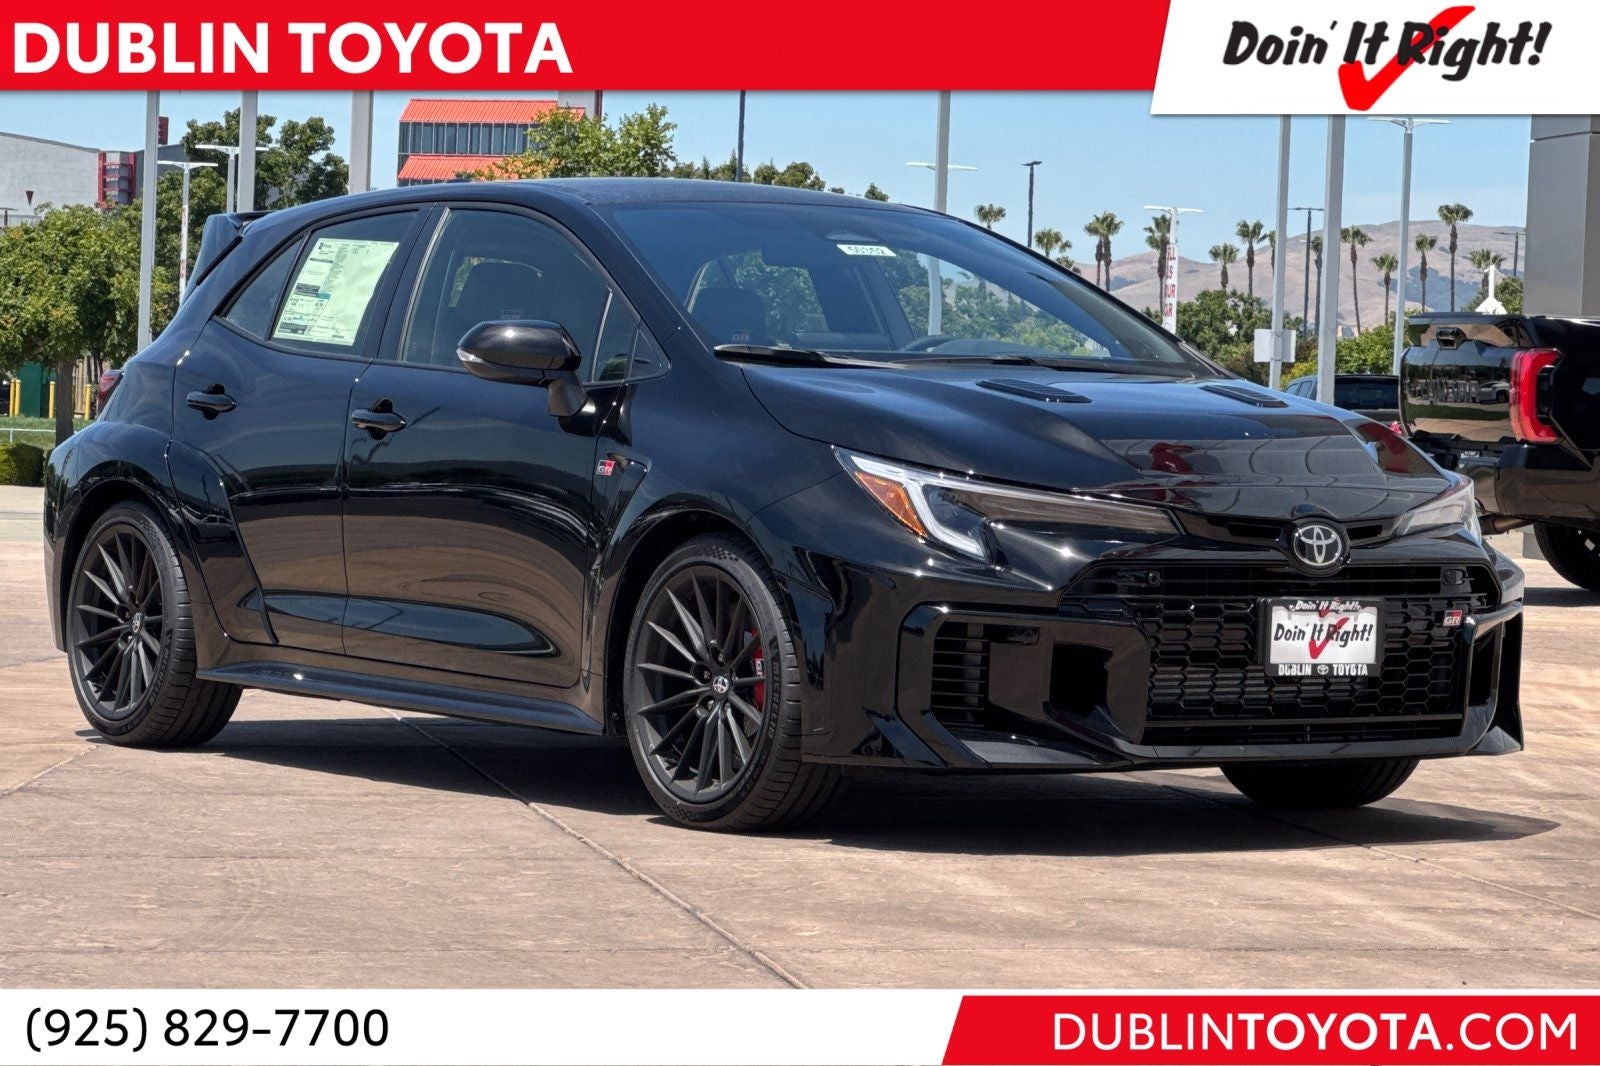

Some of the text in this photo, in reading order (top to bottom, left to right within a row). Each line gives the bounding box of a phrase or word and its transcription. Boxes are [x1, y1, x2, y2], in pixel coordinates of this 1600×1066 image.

[1311, 623, 1323, 641] It
[1326, 623, 1373, 648] Right!
[1278, 664, 1368, 675] DUBLIN TOYOTA
